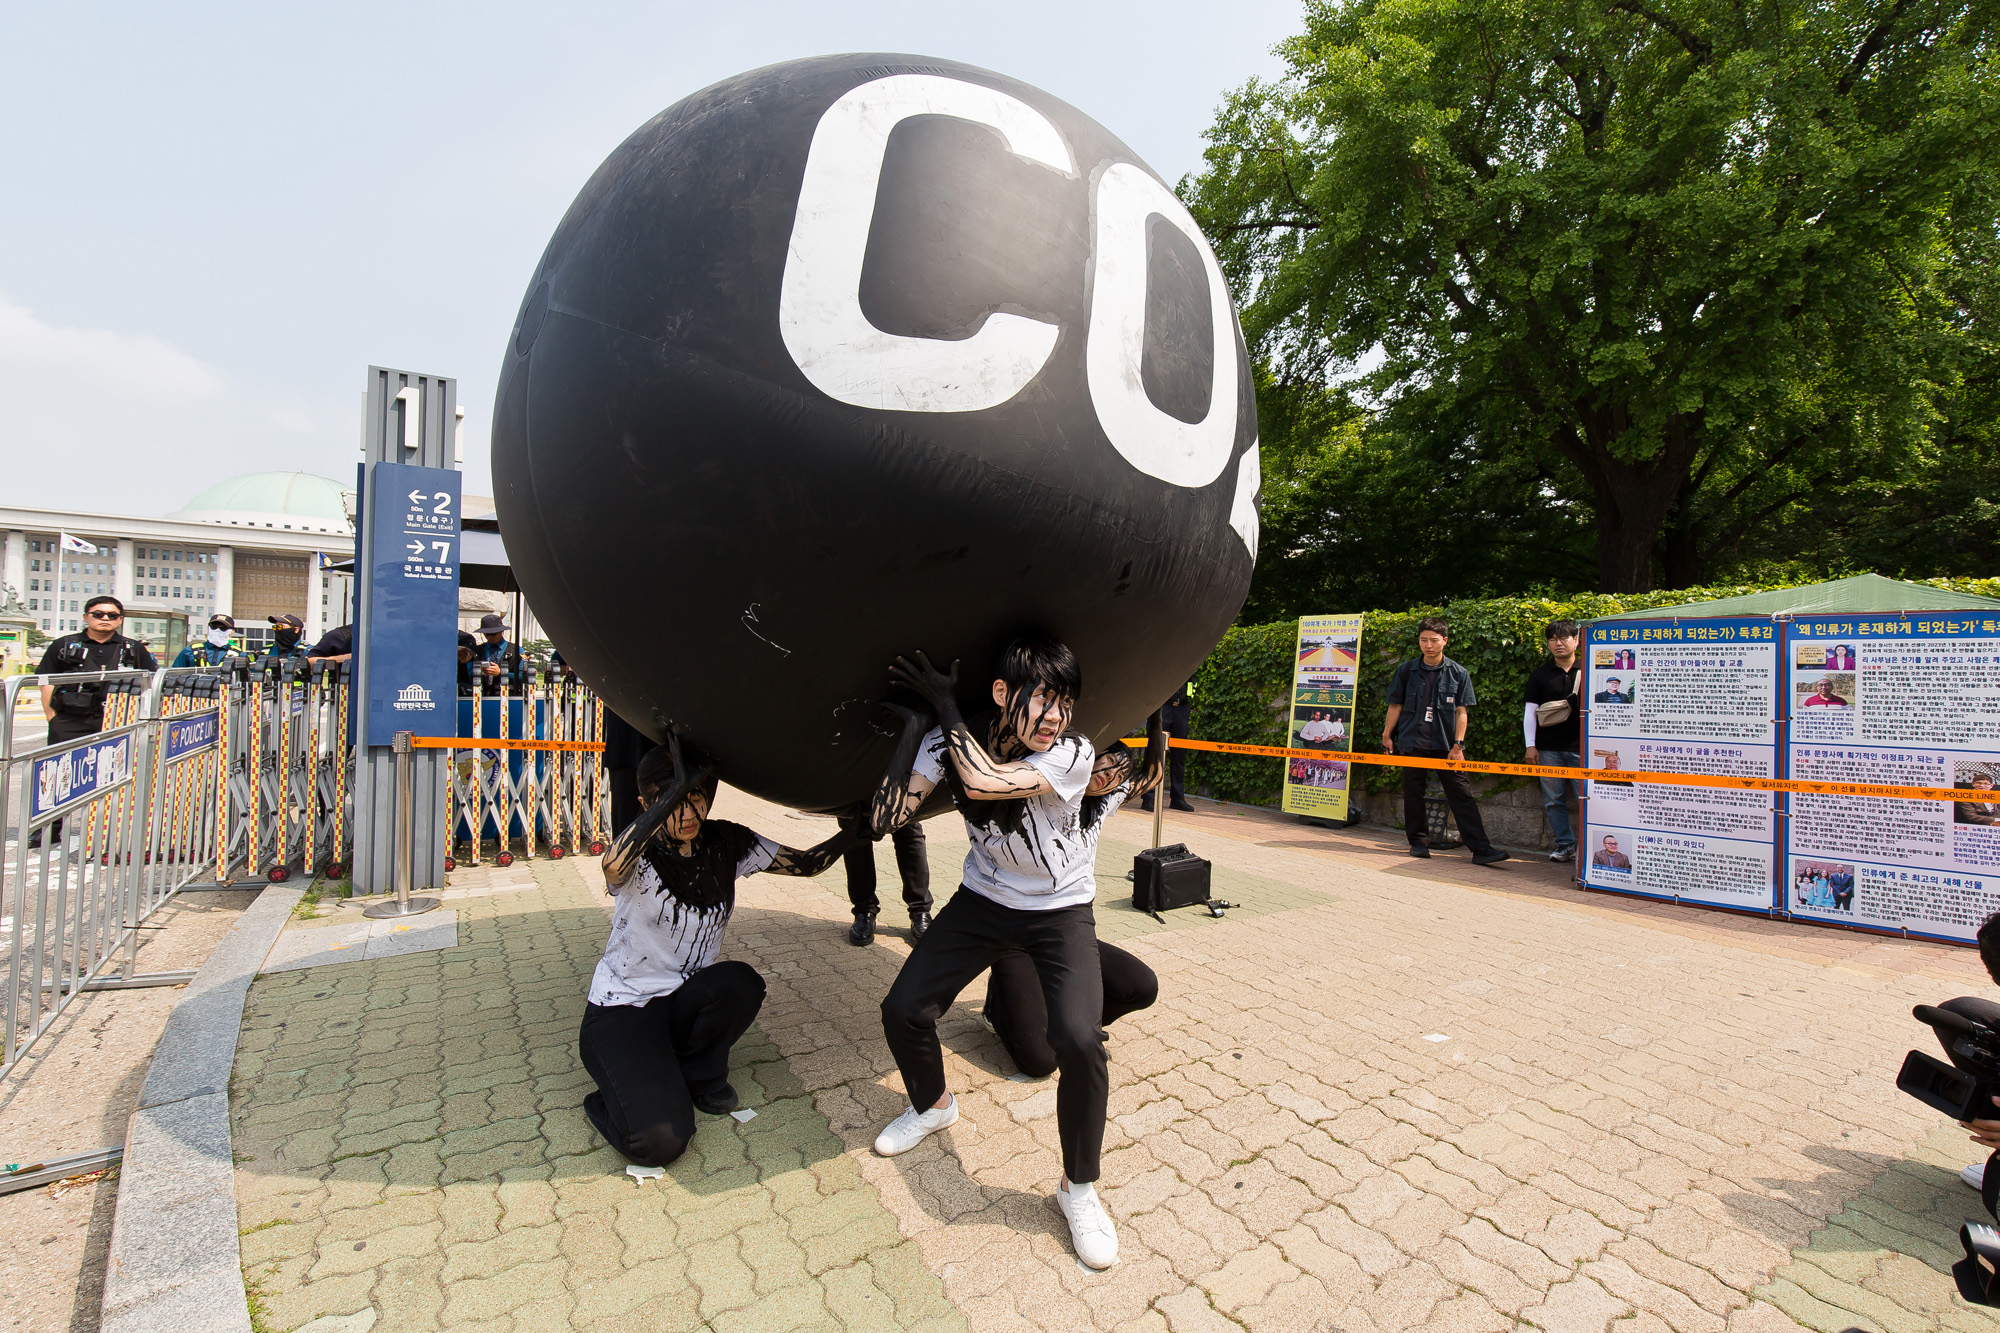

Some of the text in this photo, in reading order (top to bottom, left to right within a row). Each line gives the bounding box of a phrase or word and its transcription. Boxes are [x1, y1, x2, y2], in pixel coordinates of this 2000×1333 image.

[396, 386, 419, 448] 1
[434, 492, 451, 514] 2
[432, 541, 450, 564] 7
[1610, 629, 1639, 640] 인류가
[1642, 628, 1683, 640] 존재하게
[1739, 626, 1773, 639] 독후감
[1815, 622, 1853, 635] 인류가
[1858, 621, 1912, 635] 존재하게
[1917, 620, 1979, 634] 되었는가'
[179, 722, 204, 748] POLICE
[1656, 746, 1684, 754] 사람에게
[1713, 749, 1743, 758] 추천한다
[1814, 750, 1843, 759] 문명사에
[1848, 752, 1878, 760] 획기적인
[1881, 753, 1913, 762] 이정표가
[1917, 755, 1933, 764] 되는
[1461, 762, 1490, 770] 질서유지선
[1535, 767, 1569, 776] 넘지마시오!
[1761, 781, 1799, 790] 질서유지선
[1859, 786, 1904, 796] 넘지마시오!
[1684, 840, 1705, 849] 와있다
[1862, 868, 1983, 890] 인류에게 준 최고의 새해 선물
